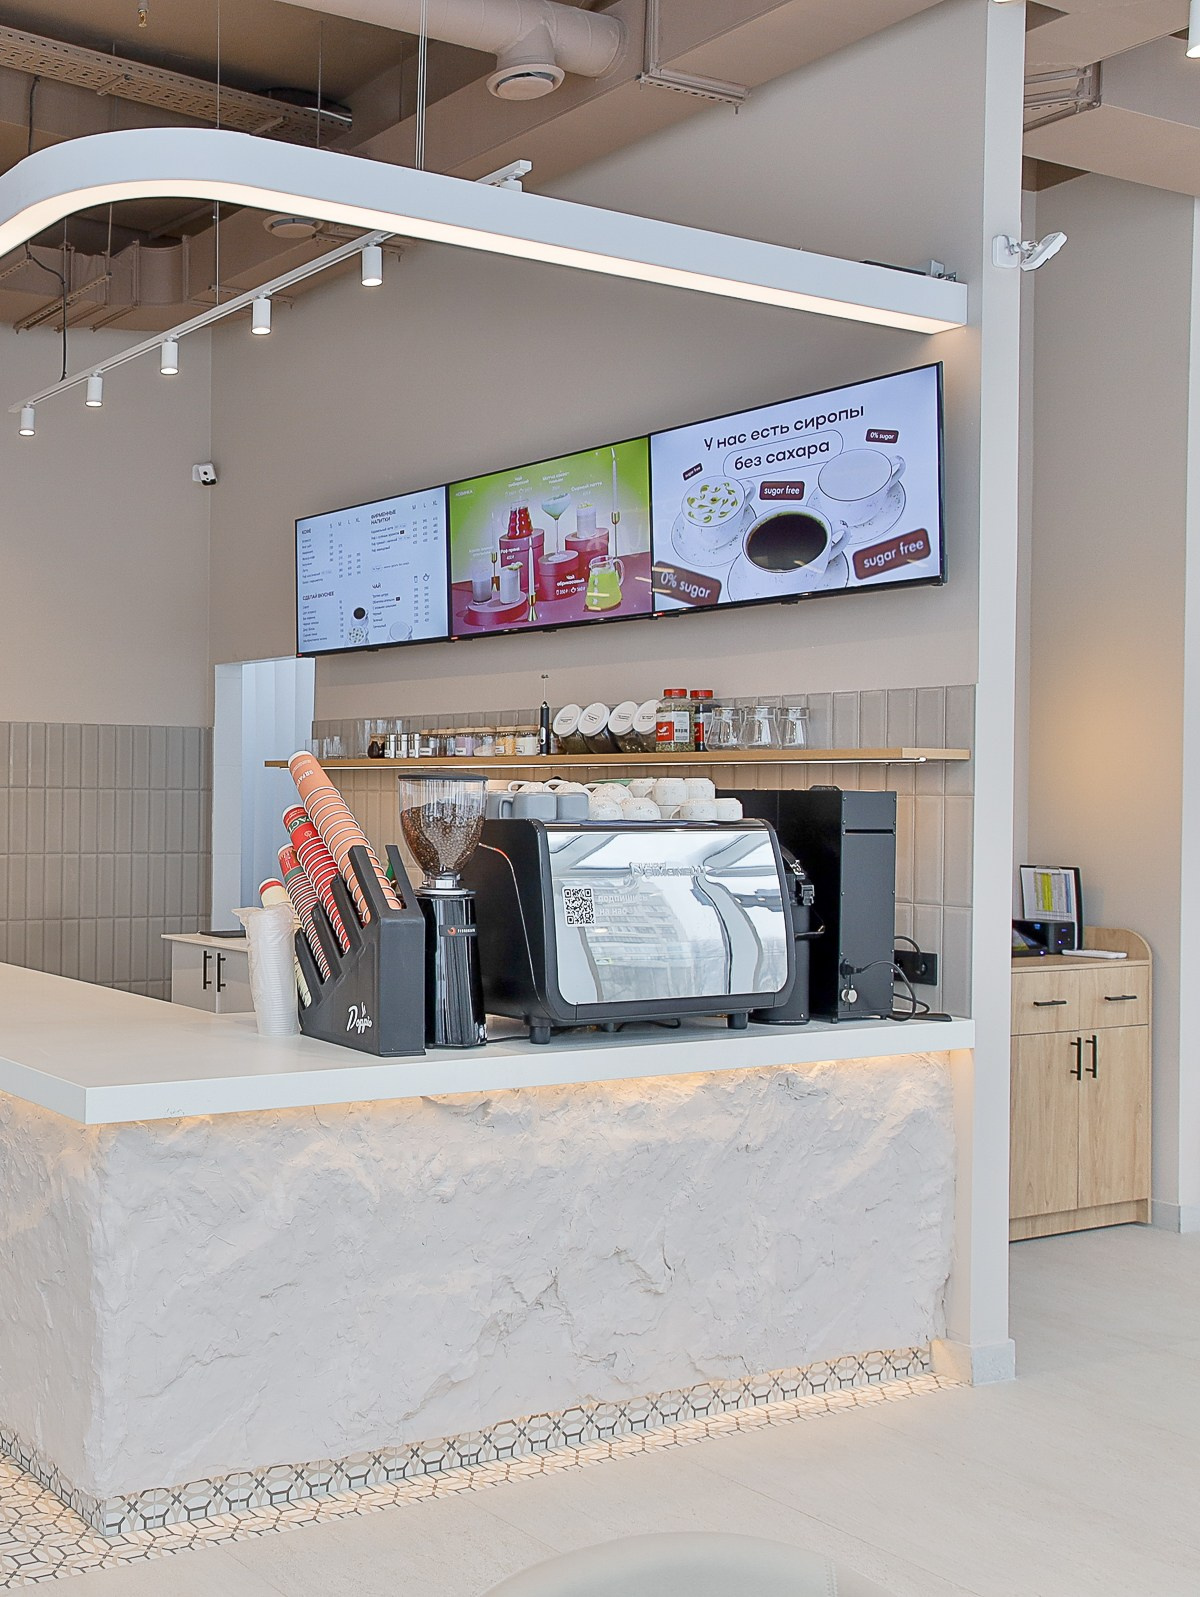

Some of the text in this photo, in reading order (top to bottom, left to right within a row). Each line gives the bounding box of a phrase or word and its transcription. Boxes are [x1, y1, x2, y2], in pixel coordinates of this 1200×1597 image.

[703, 405, 865, 451] У нас есть сиропы
[879, 433, 895, 441] sugar
[734, 439, 830, 471] без сахара
[763, 485, 800, 496] sugar free
[863, 538, 924, 570] sugar free
[660, 571, 711, 600] 0% sugar
[346, 1004, 373, 1034] Doppio
